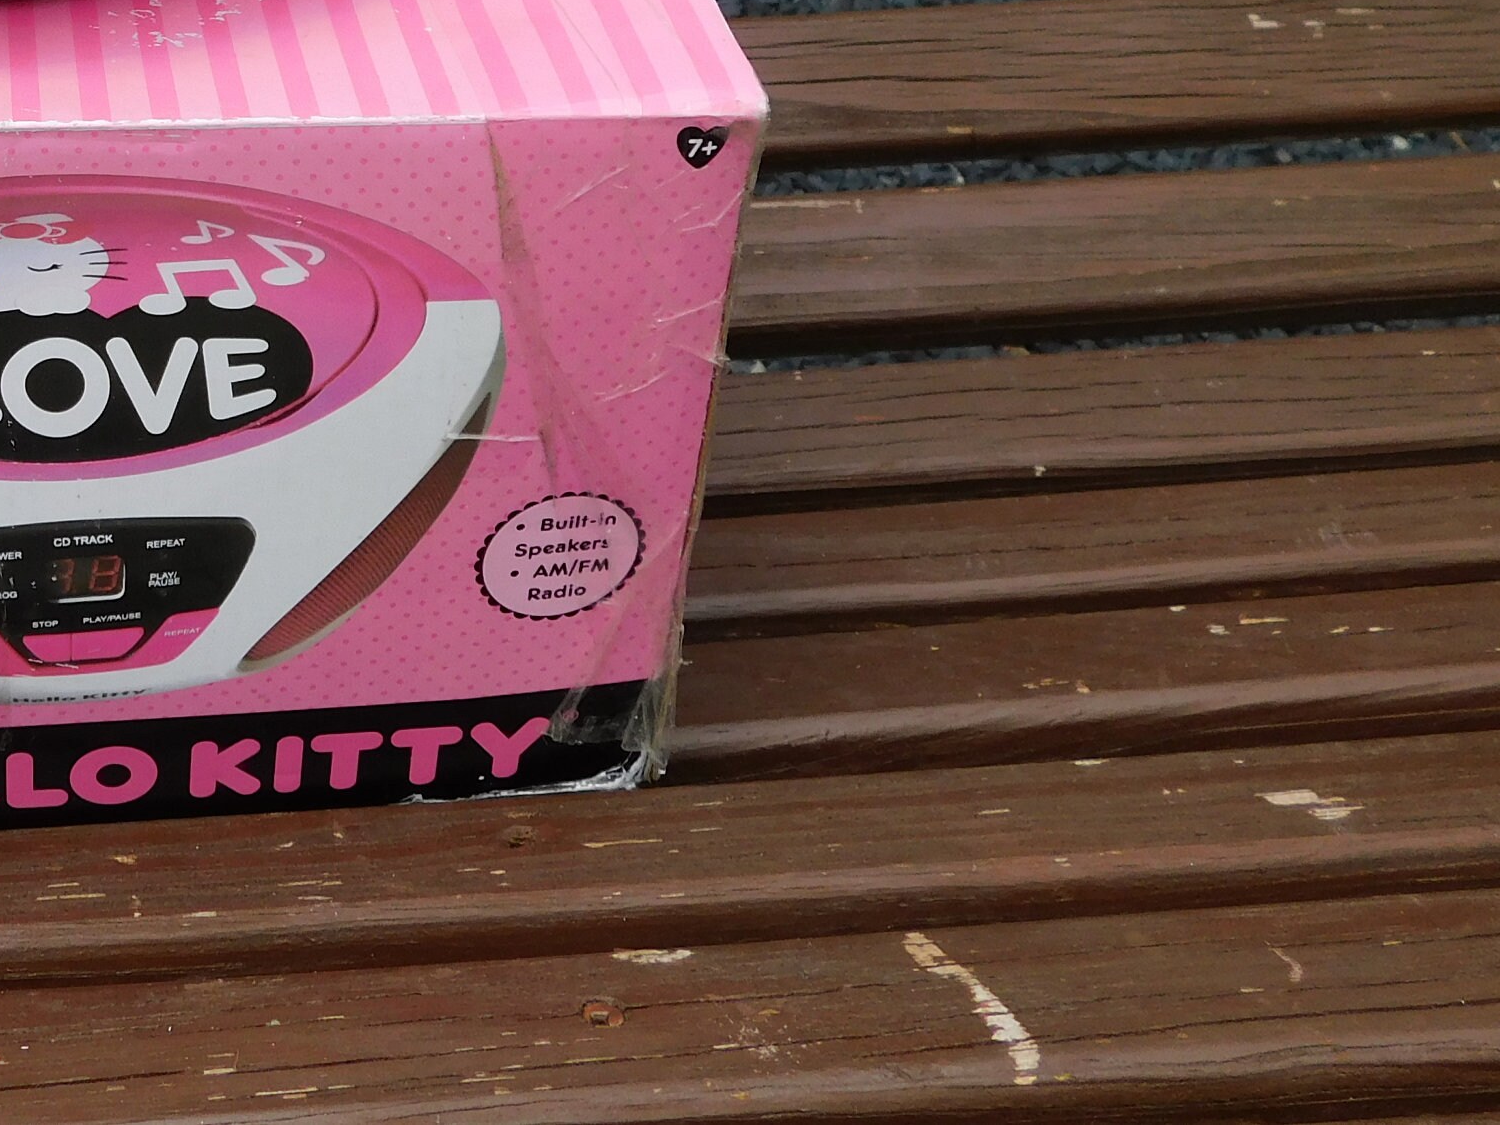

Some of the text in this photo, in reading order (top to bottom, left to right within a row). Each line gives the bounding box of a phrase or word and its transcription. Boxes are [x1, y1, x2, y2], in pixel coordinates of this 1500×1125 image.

[688, 138, 718, 158] 7+
[540, 512, 617, 532] Built-in
[53, 534, 114, 547] CD TRACK
[146, 538, 186, 549] REPEAT
[514, 538, 609, 559] Speakers
[533, 558, 609, 578] AM/FM
[148, 577, 181, 588] PAUSE
[528, 584, 587, 601] Radio
[32, 620, 59, 629] STOP
[83, 612, 142, 624] PLAY/PAUSE
[164, 627, 202, 637] REPEAT
[189, 716, 551, 798] KITTY
